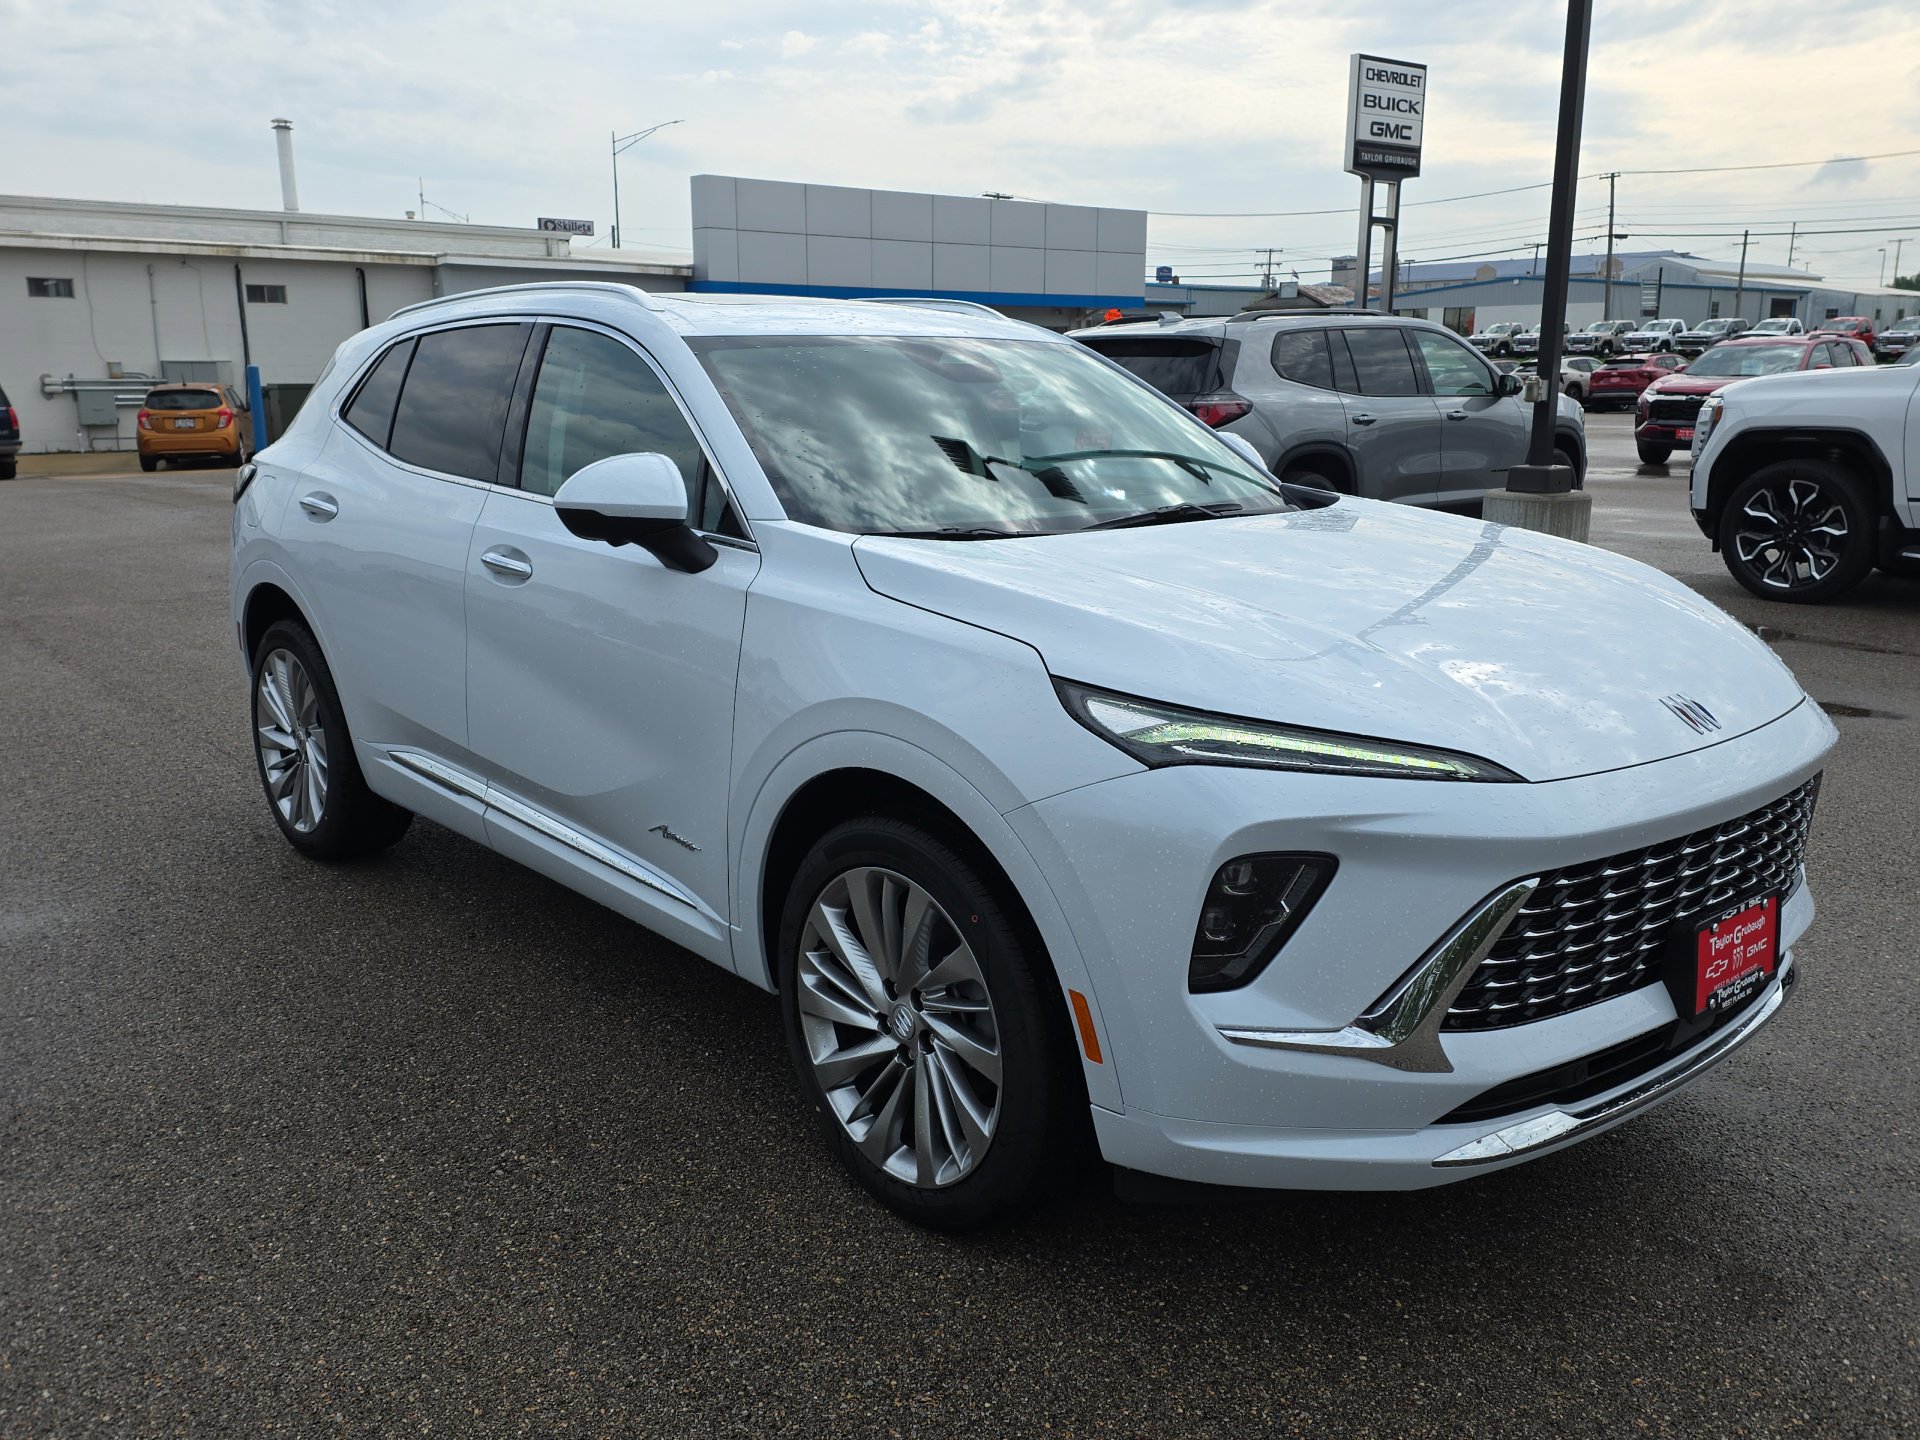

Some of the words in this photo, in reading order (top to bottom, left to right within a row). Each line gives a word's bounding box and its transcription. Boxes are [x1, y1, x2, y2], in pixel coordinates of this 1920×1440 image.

[1366, 67, 1422, 88] CHEVROLET
[1363, 93, 1420, 115] BUICK
[1370, 121, 1412, 140] GMC
[1361, 152, 1383, 163] TAYLOR
[1709, 933, 1733, 956] Taylor
[1734, 916, 1766, 944] Grubaugh
[1747, 938, 1767, 957] GMC
[1716, 985, 1734, 1003] Taylor
[1733, 971, 1759, 994] Grubaugh
